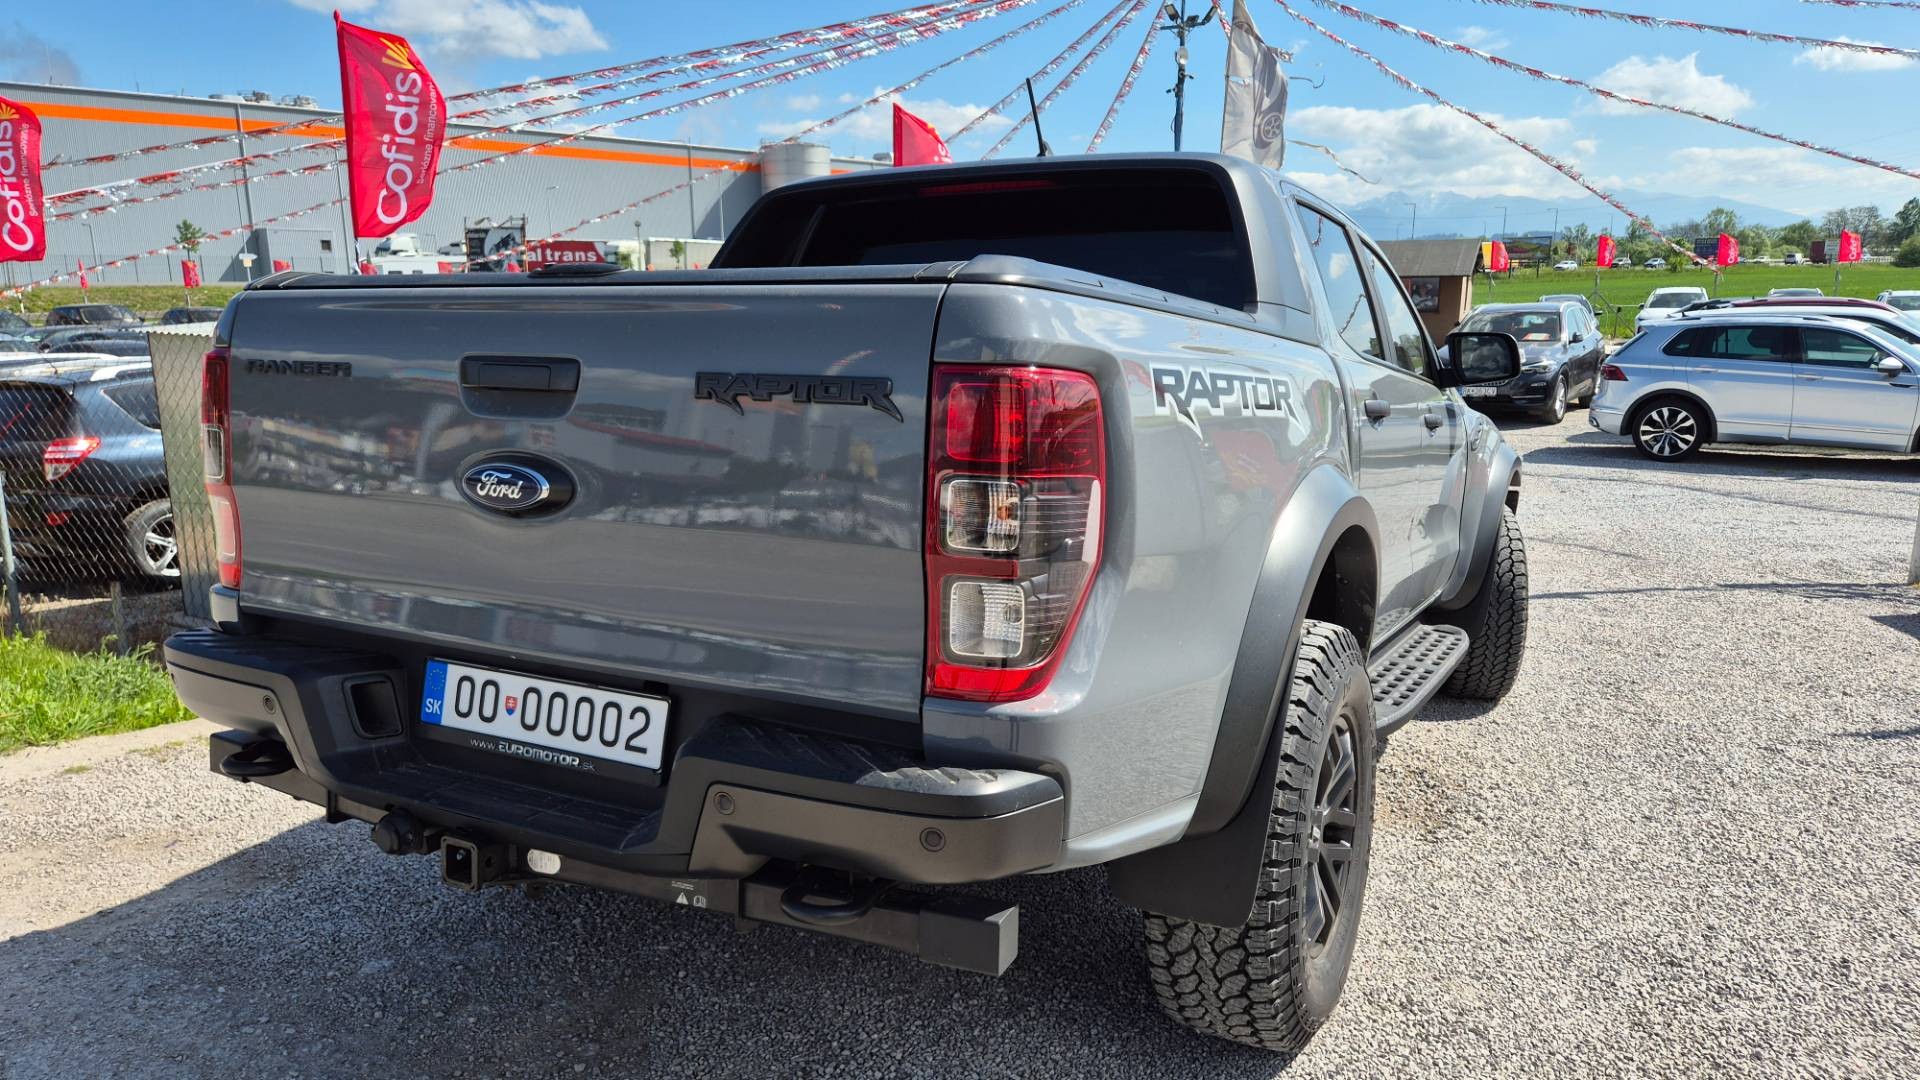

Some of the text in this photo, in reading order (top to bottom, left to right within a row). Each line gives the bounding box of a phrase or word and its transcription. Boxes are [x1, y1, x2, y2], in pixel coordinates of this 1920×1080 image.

[375, 72, 422, 225] Cofidis
[545, 248, 597, 262] trans
[245, 359, 352, 377] RANGER
[695, 371, 904, 423] RAPTOR
[1150, 363, 1305, 436] RAPTOR
[476, 470, 523, 499] Ford
[425, 698, 442, 716] SK
